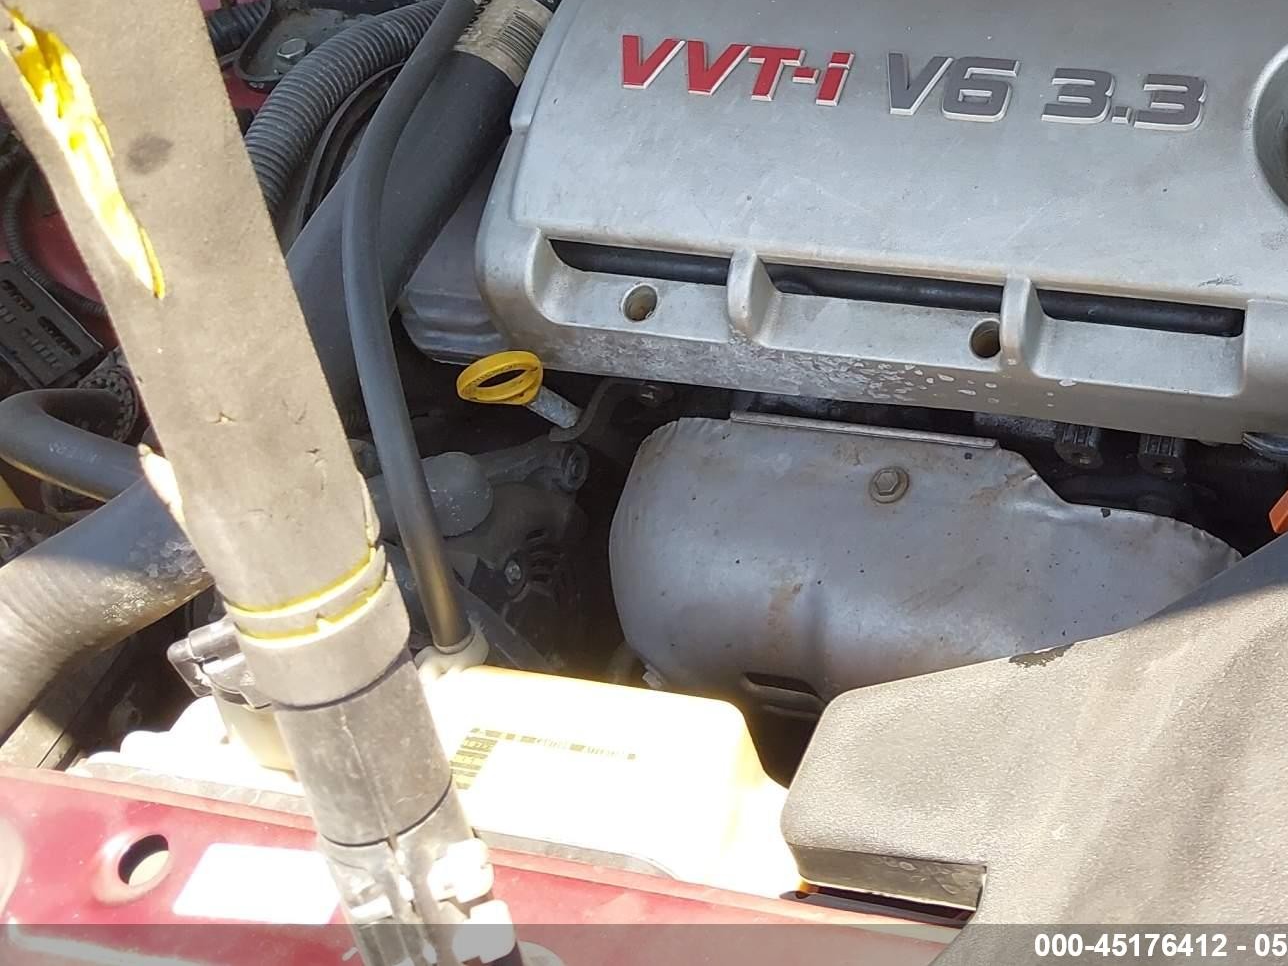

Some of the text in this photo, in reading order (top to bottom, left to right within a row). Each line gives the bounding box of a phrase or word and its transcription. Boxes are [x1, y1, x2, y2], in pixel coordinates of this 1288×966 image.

[621, 34, 1207, 132] VVT-i V6 3.3
